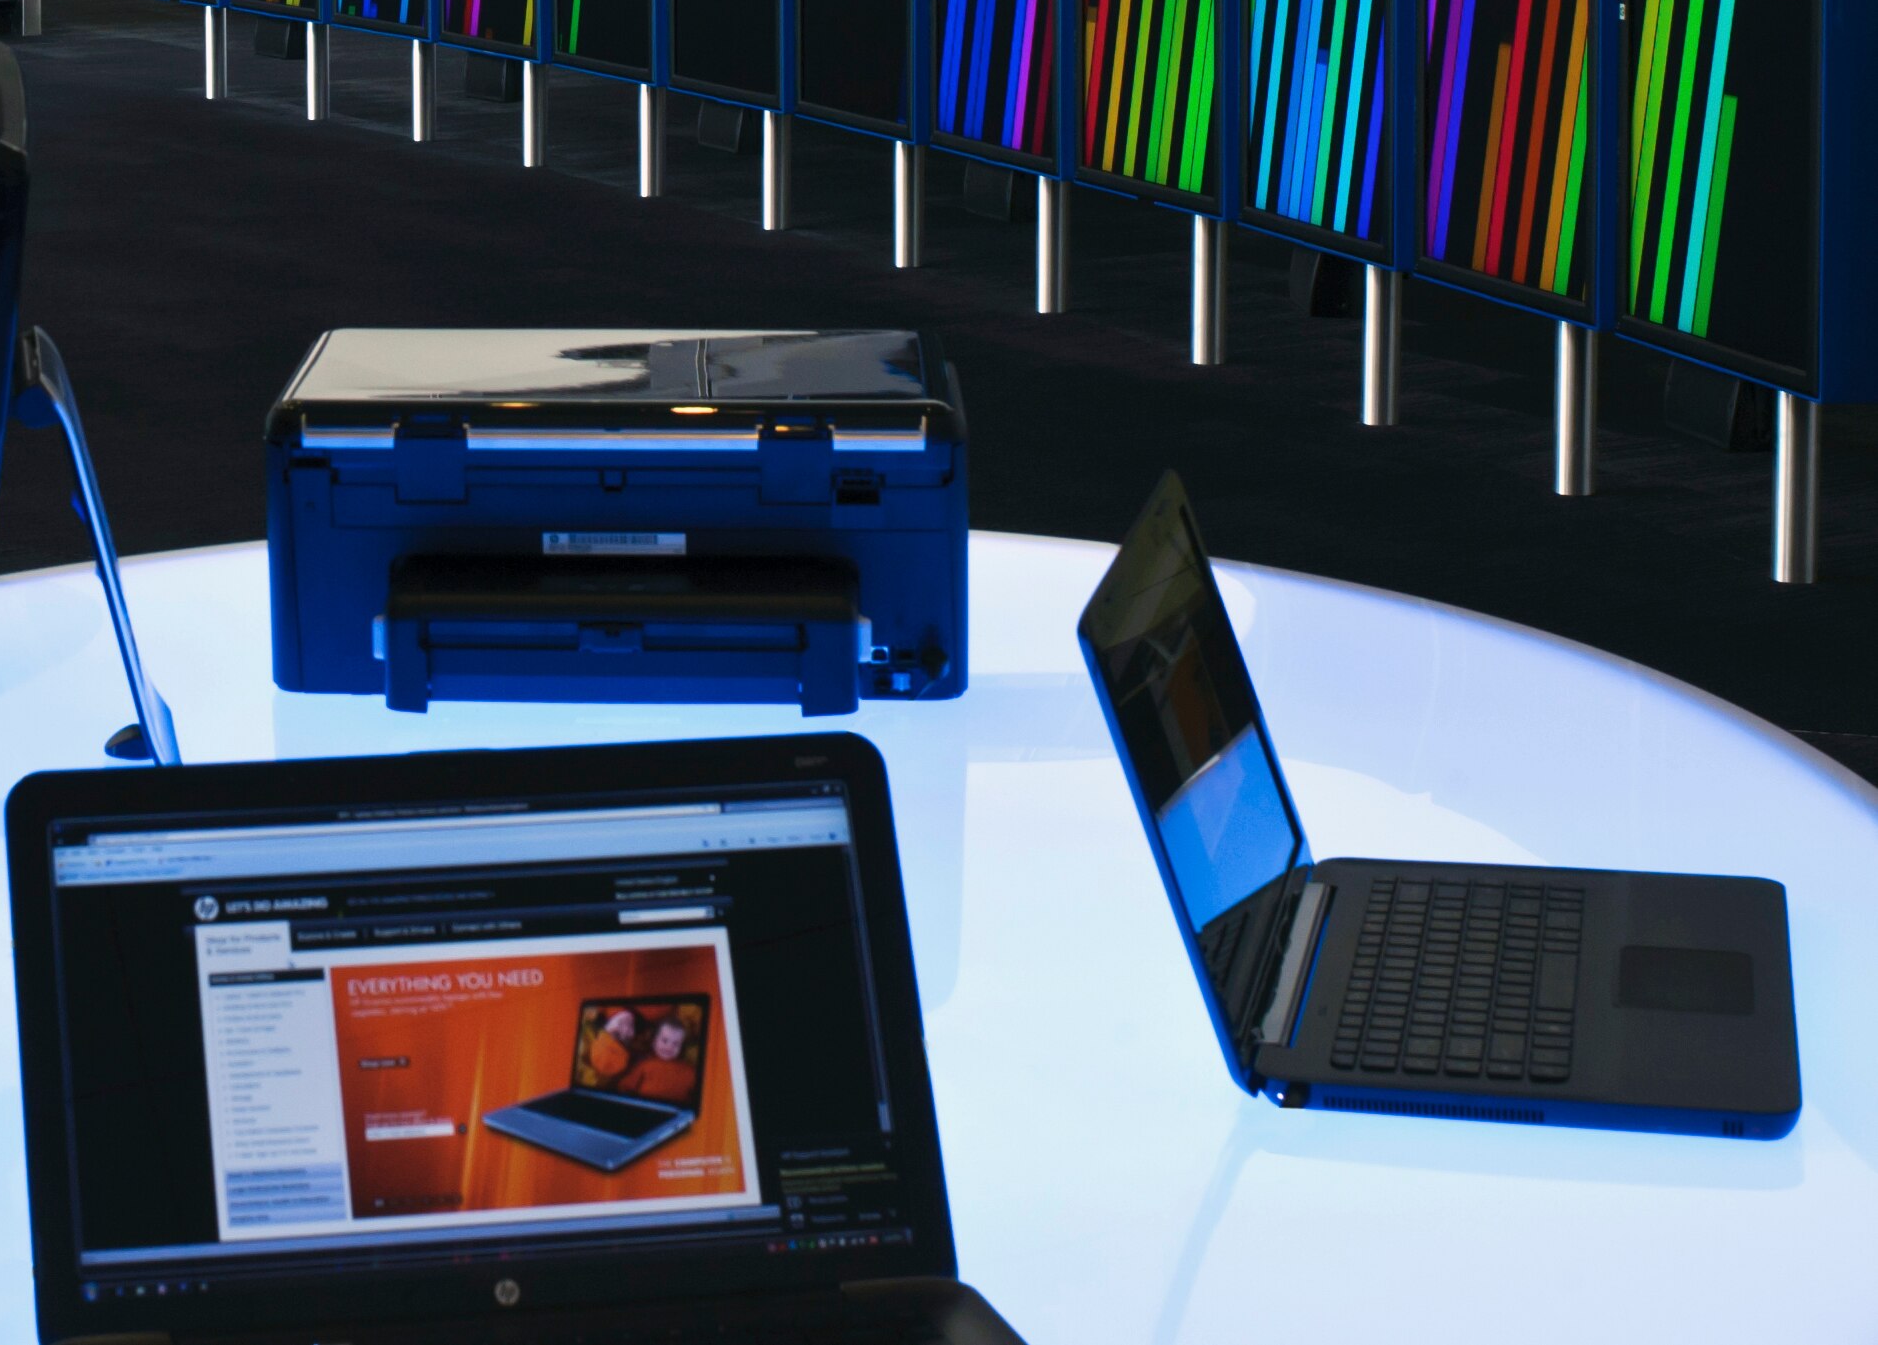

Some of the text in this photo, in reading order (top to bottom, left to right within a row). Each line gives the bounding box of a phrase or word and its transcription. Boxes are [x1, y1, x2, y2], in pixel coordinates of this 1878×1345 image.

[347, 968, 544, 997] EVERYTHING YOU NEED
